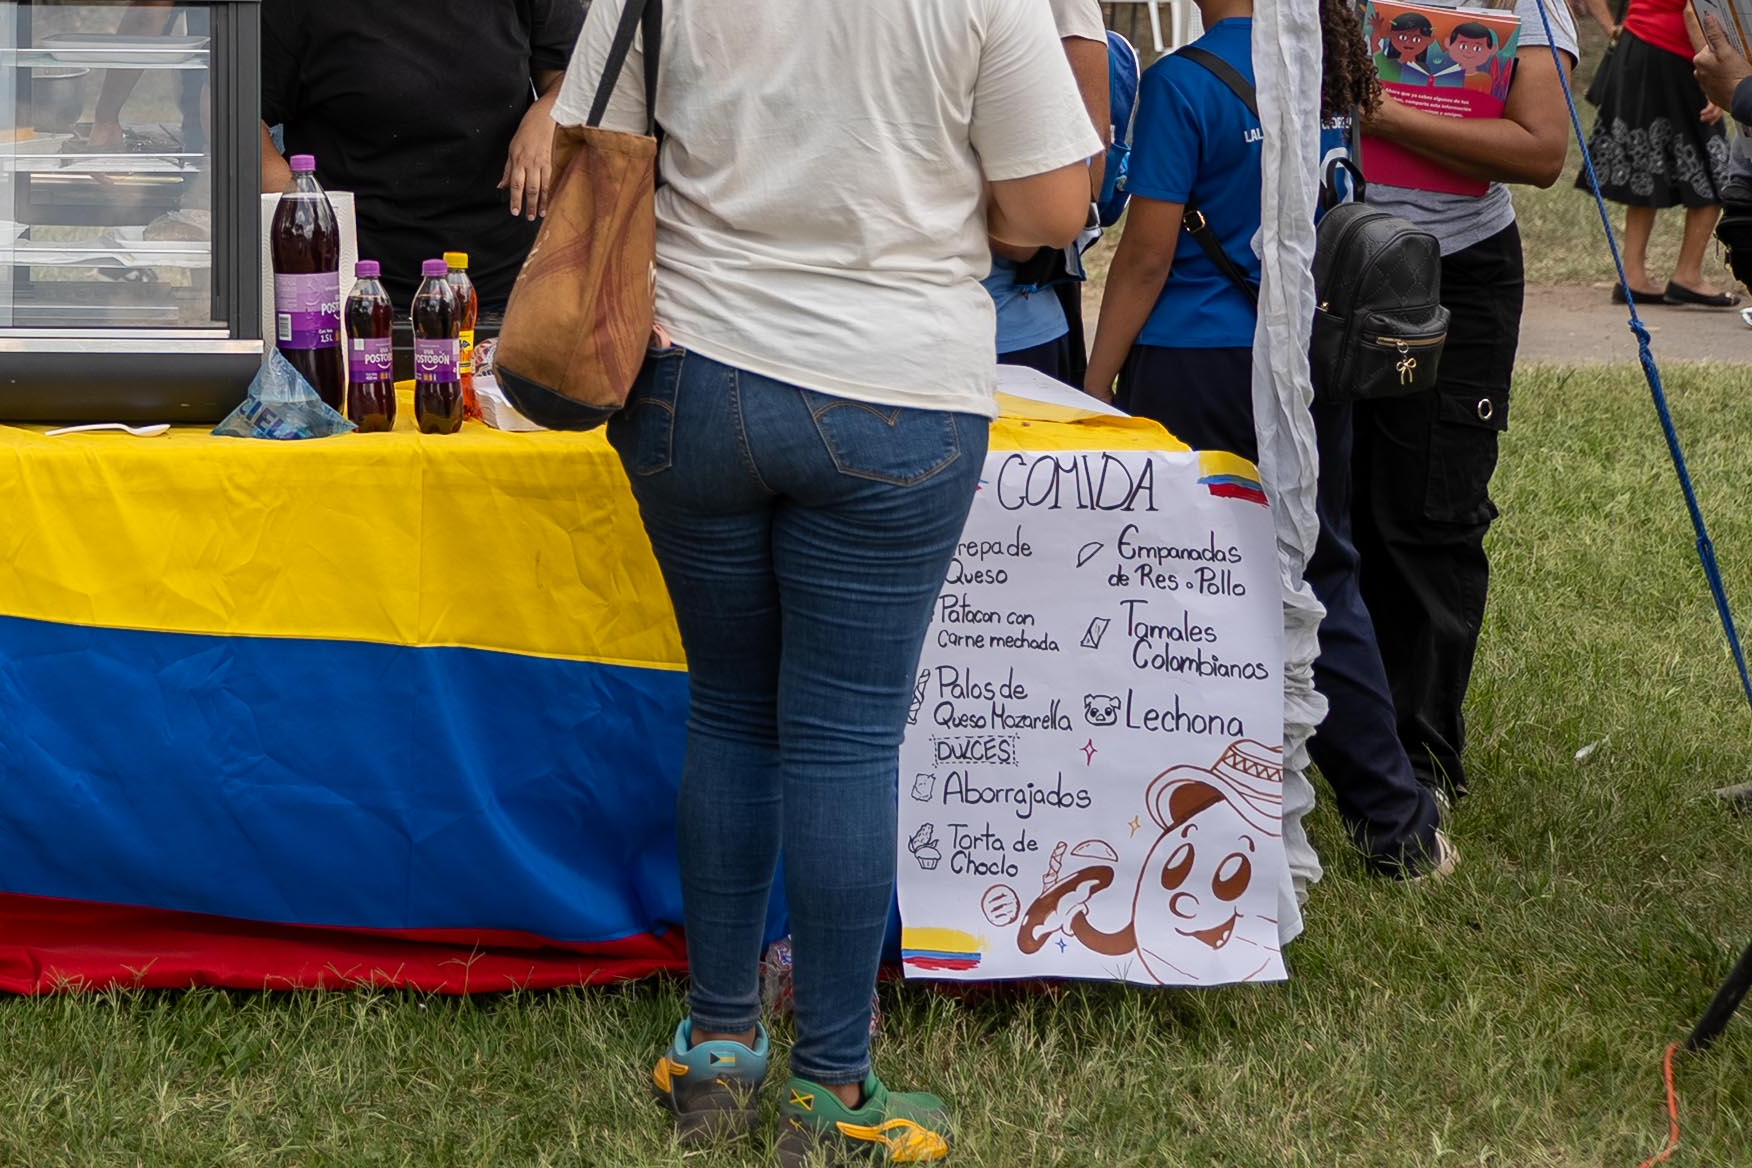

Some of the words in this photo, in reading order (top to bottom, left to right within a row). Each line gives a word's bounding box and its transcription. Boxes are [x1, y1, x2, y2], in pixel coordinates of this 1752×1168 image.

[321, 301, 341, 316] POST
[364, 353, 392, 365] POSTOB
[997, 452, 1159, 511] COMIDA
[957, 541, 1004, 561] repa
[1007, 525, 1032, 557] de
[1117, 524, 1242, 566] Empanadas
[945, 558, 1008, 585] Queso
[1108, 564, 1130, 586] de
[1134, 563, 1179, 591] Res
[1194, 566, 1246, 596] Pollo
[939, 593, 1000, 624] Patacon
[1006, 612, 1035, 626] con
[1120, 599, 1217, 643] Tamales
[938, 630, 985, 648] Carne
[989, 629, 1060, 652] mechada
[1132, 638, 1269, 680] Colombianos
[935, 665, 995, 701] Palos
[999, 666, 1028, 700] de
[933, 701, 987, 730] Queso
[991, 699, 1073, 731] Mozarella
[1126, 688, 1244, 737] Lechona
[937, 738, 1012, 762] DULCES
[943, 770, 1092, 819] Aborrajados
[947, 821, 1005, 852] Torta
[1012, 829, 1039, 852] de
[950, 850, 1018, 877] Choclo
